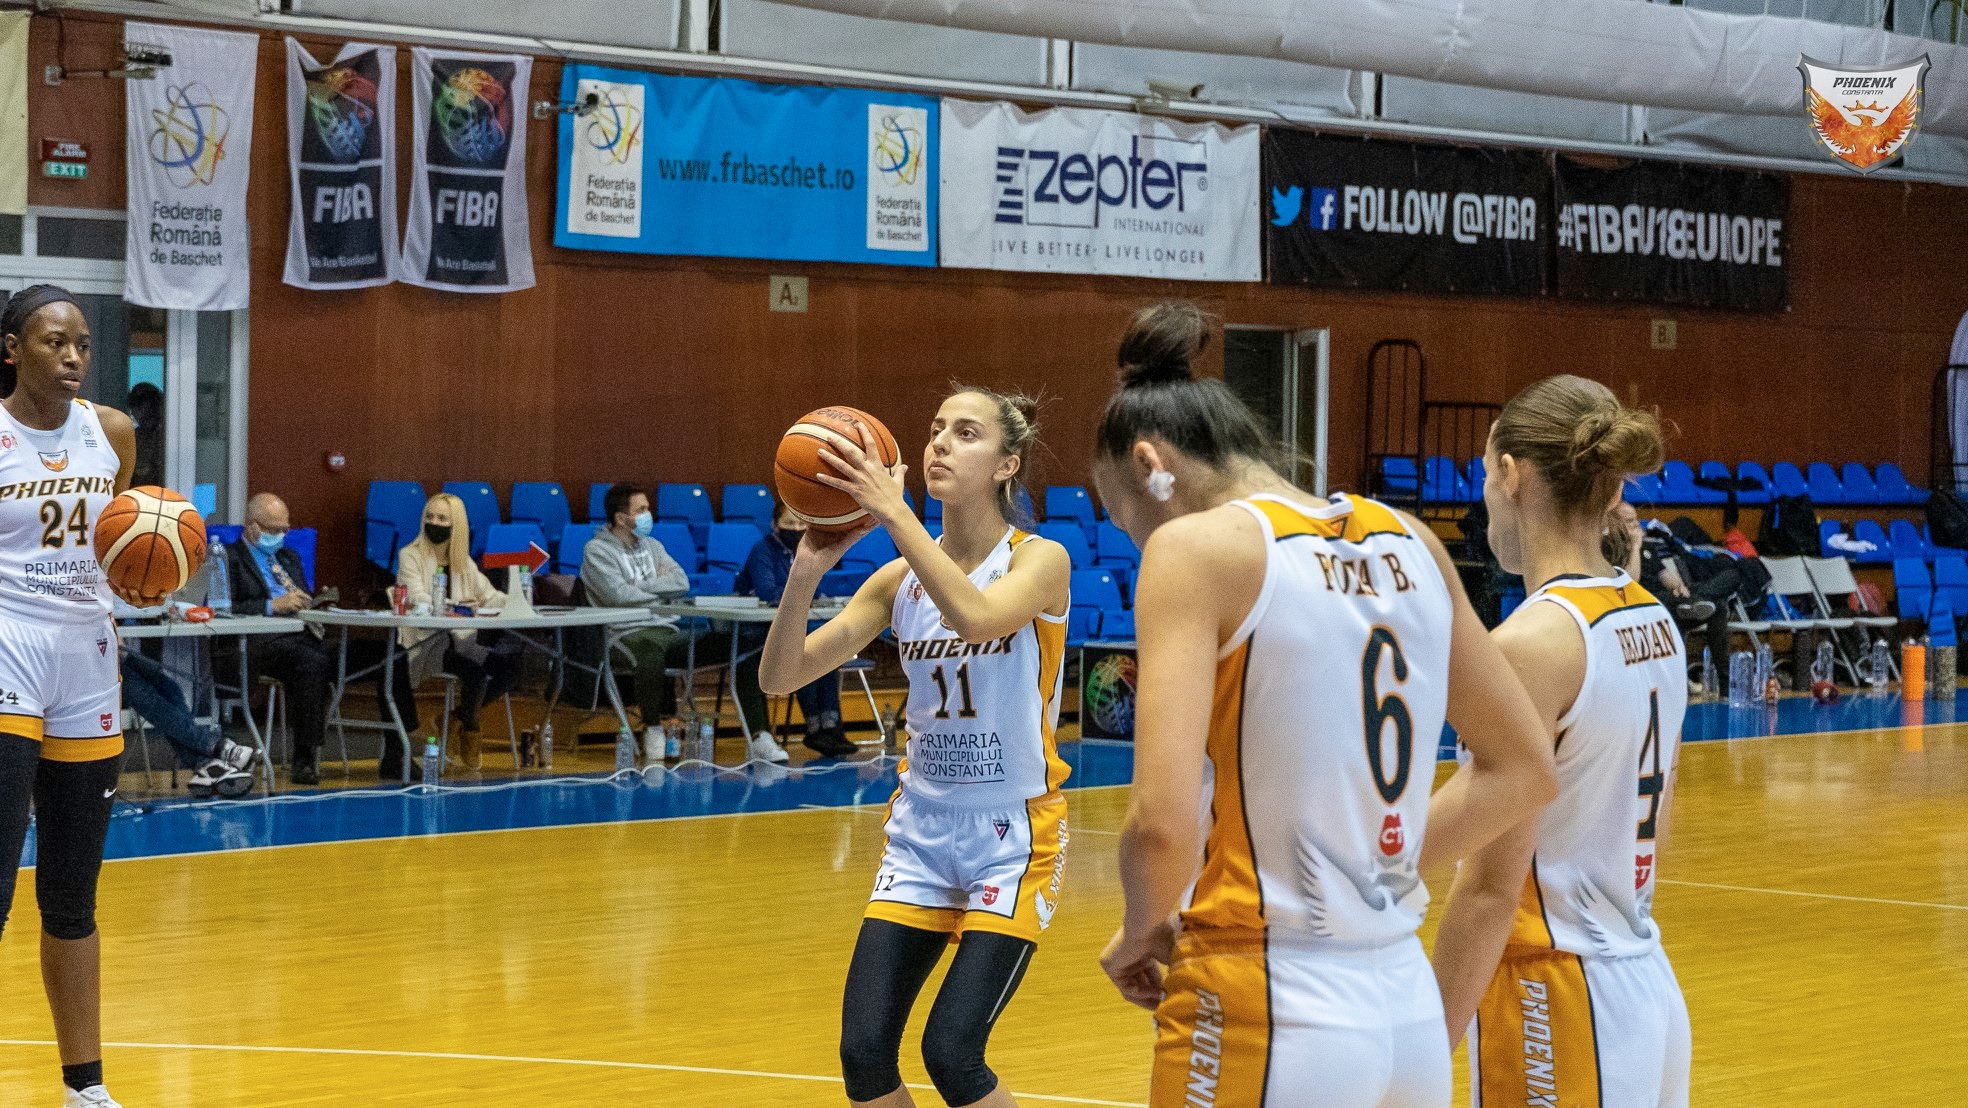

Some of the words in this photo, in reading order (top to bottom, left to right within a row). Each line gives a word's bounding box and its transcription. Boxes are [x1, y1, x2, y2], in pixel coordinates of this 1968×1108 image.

[50, 162, 86, 176] EXIT
[659, 151, 854, 191] www.frbaschet.ro
[314, 183, 373, 223] FIBA
[436, 189, 499, 227] FIBA
[1343, 185, 1447, 235] FOLLOW
[1453, 192, 1536, 244] @FIBA
[151, 223, 222, 247] Română
[150, 249, 168, 264] de
[171, 250, 223, 267] Baschet
[992, 239, 1027, 255] LIVE
[1105, 244, 1139, 260] LIVE
[0, 477, 112, 501] PHOENIX
[40, 498, 89, 549] 24
[25, 560, 98, 575] PRIMARIA
[26, 574, 98, 586] MUNICIPIULUI
[28, 584, 98, 597] CONSTANTA
[901, 631, 1018, 662] PHOENIX
[931, 662, 977, 720] 11
[1361, 626, 1413, 807] 6
[920, 732, 1002, 749] PRIMARIA
[920, 749, 1003, 762] MUNICIPIULUI
[1636, 687, 1664, 842] 4
[922, 763, 1005, 777] CONSTANTA
[981, 889, 999, 901] CT
[1184, 987, 1224, 1108] PHOENI
[1519, 978, 1559, 1108] PHOENIX
